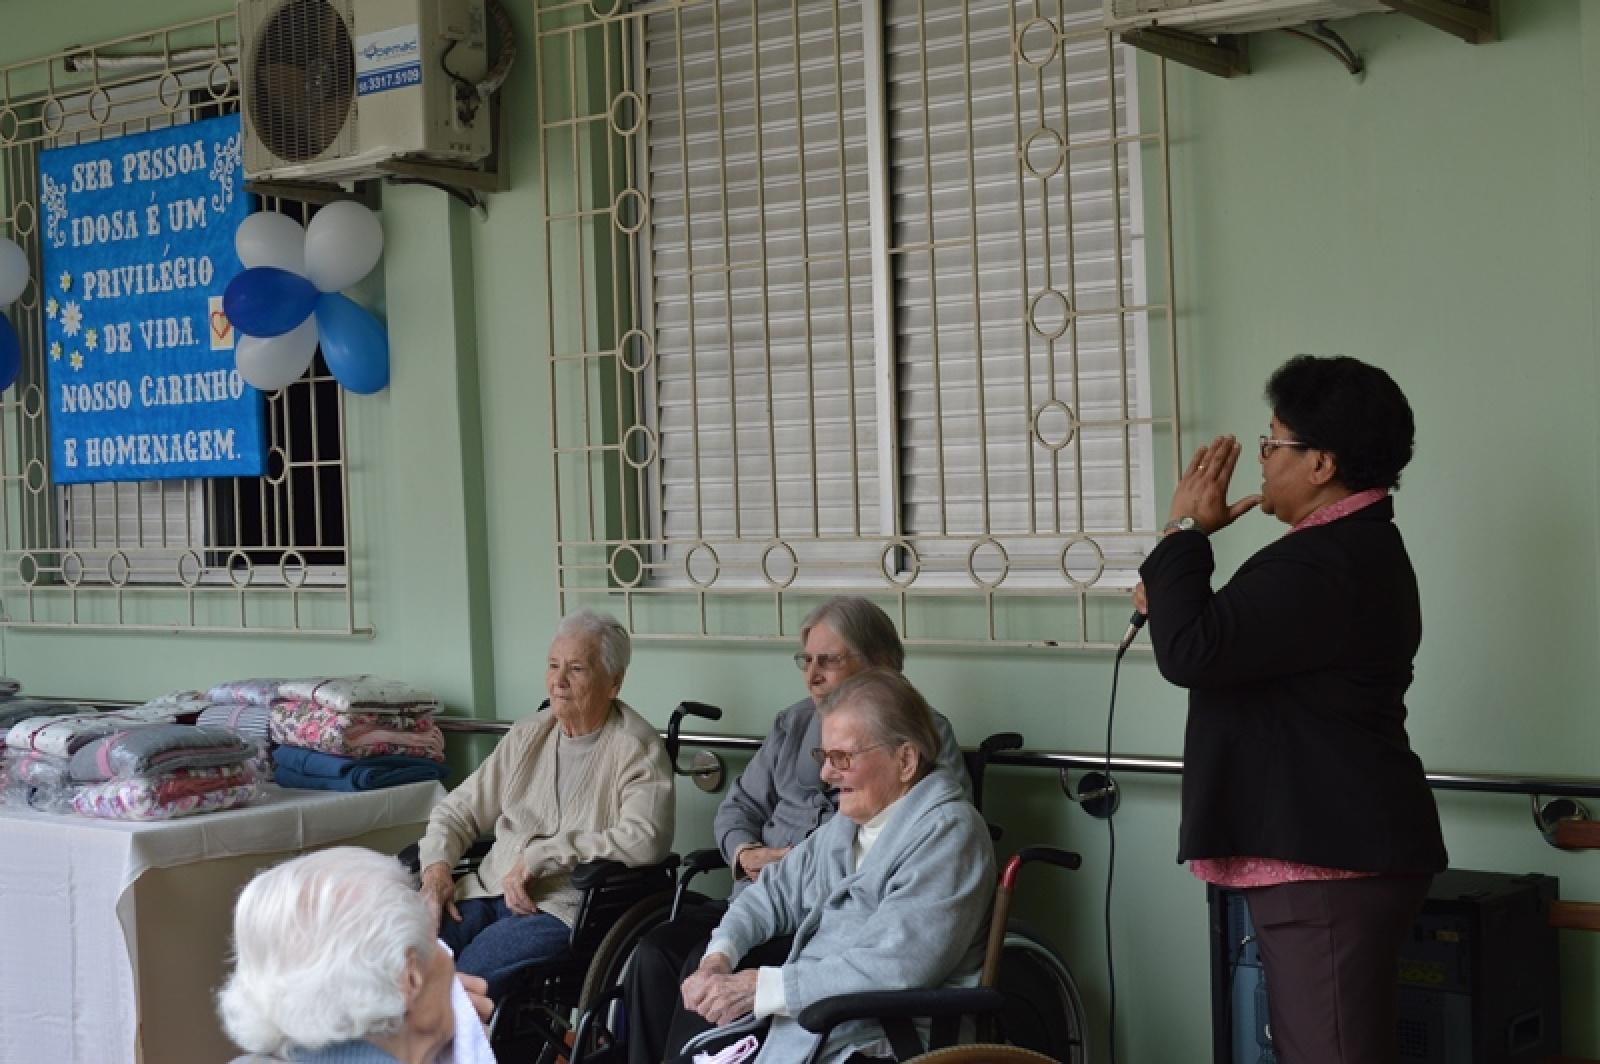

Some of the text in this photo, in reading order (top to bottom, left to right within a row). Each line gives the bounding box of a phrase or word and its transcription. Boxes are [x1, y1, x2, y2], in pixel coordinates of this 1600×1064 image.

[72, 140, 206, 192] SER PESSOA
[72, 192, 206, 246] IDOSA É UM
[83, 244, 214, 300] PRIVILÉGIO
[104, 317, 199, 353] DE VIDA.
[62, 368, 244, 412] NOSSO CARINHO
[64, 428, 240, 466] E HOMENAGEM.
